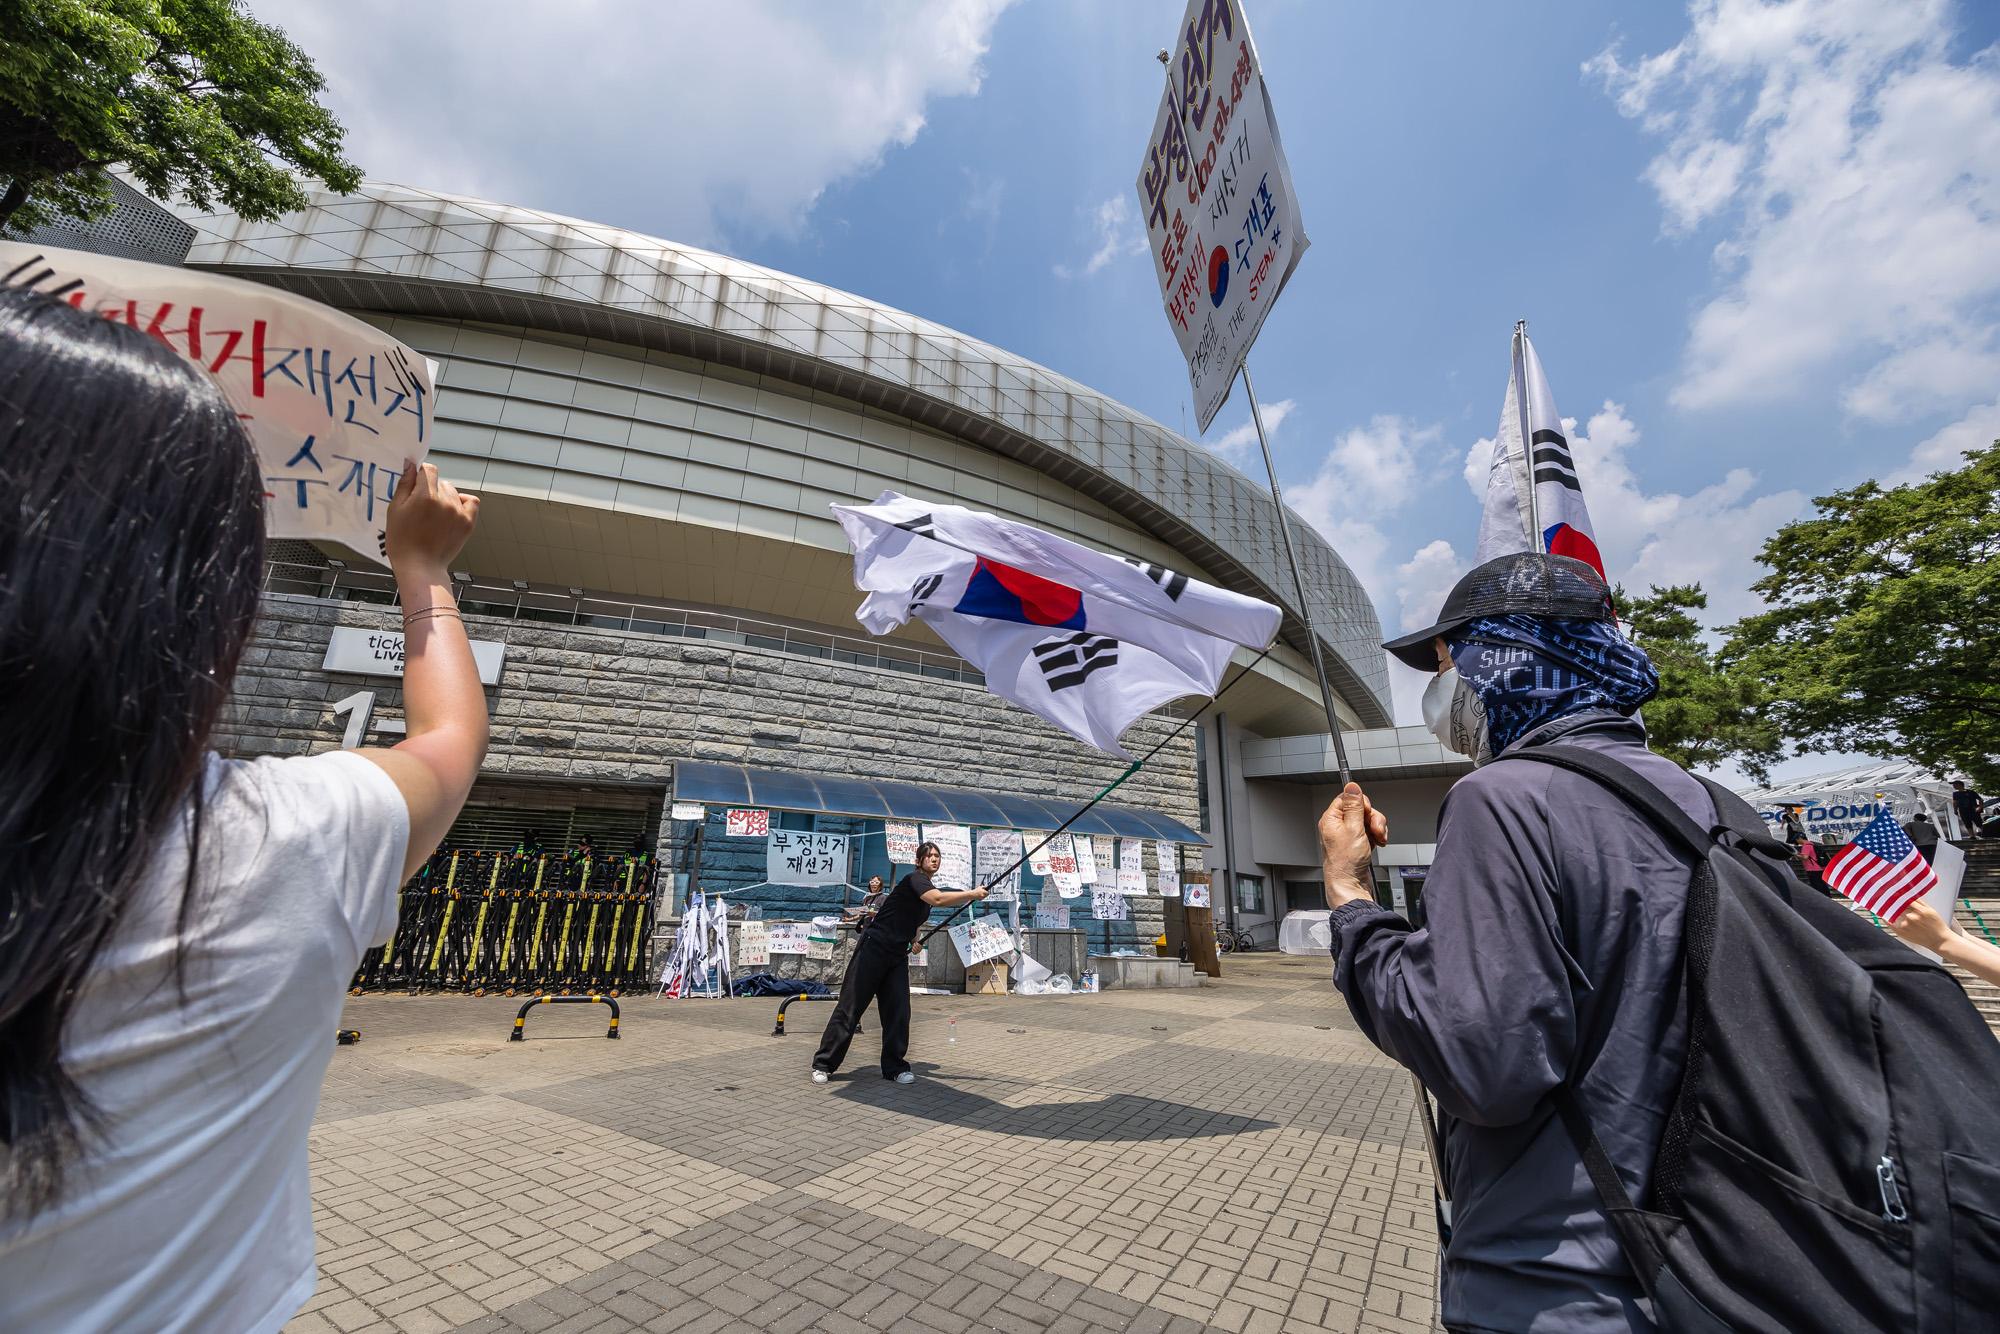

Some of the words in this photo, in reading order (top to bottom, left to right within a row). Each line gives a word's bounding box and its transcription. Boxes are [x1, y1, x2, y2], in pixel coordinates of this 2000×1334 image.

[1207, 118, 1250, 232] 재선거
[1234, 171, 1276, 274] 수개표
[1169, 232, 1207, 332] 부정선거
[1216, 336, 1228, 371] STOP
[1227, 301, 1246, 338] THE
[368, 635, 405, 650] tick
[374, 650, 405, 661] LIVE
[1808, 801, 1893, 821] DOME
[745, 823, 767, 836] D-8
[772, 832, 846, 856] 부정선거
[786, 857, 833, 875] 재선거
